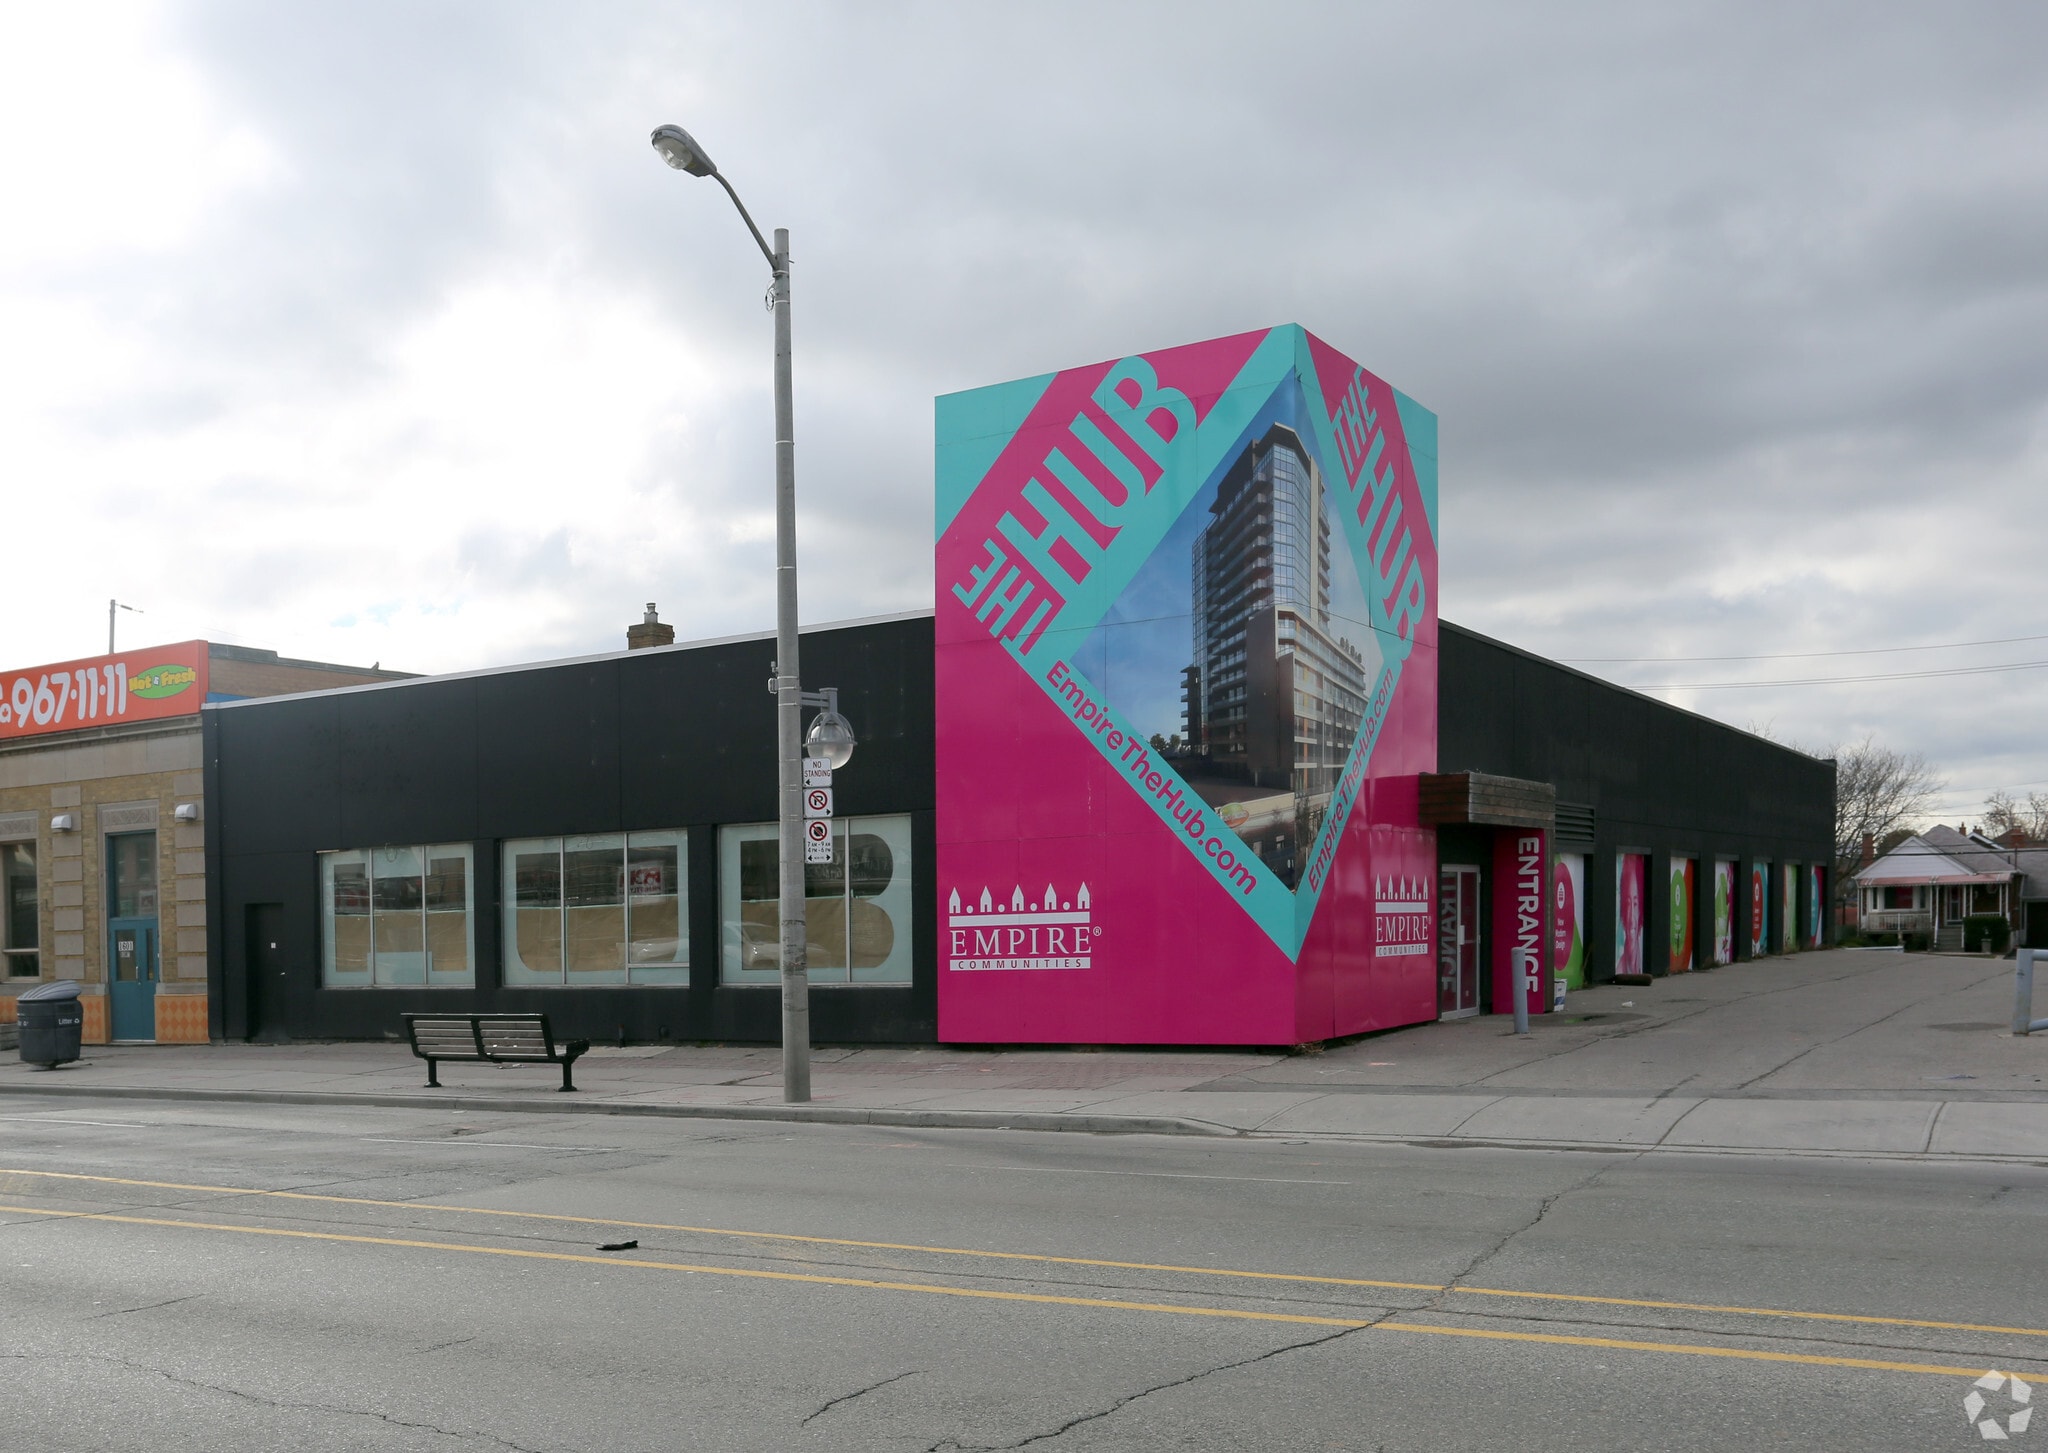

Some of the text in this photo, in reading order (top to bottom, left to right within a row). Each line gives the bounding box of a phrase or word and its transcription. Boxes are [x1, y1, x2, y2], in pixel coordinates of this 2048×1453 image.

[995, 354, 1198, 602] HUB
[1331, 365, 1377, 476] THE
[951, 538, 1053, 662] THE
[1351, 427, 1425, 661] HUB
[129, 676, 152, 691] Hot
[160, 668, 196, 687] Fresh
[804, 770, 831, 778] STANDING
[1046, 659, 1258, 896] EmpireTheHub.com
[1308, 667, 1394, 894] EmpireTheHub.com
[957, 958, 1082, 970] COMMUNITIES
